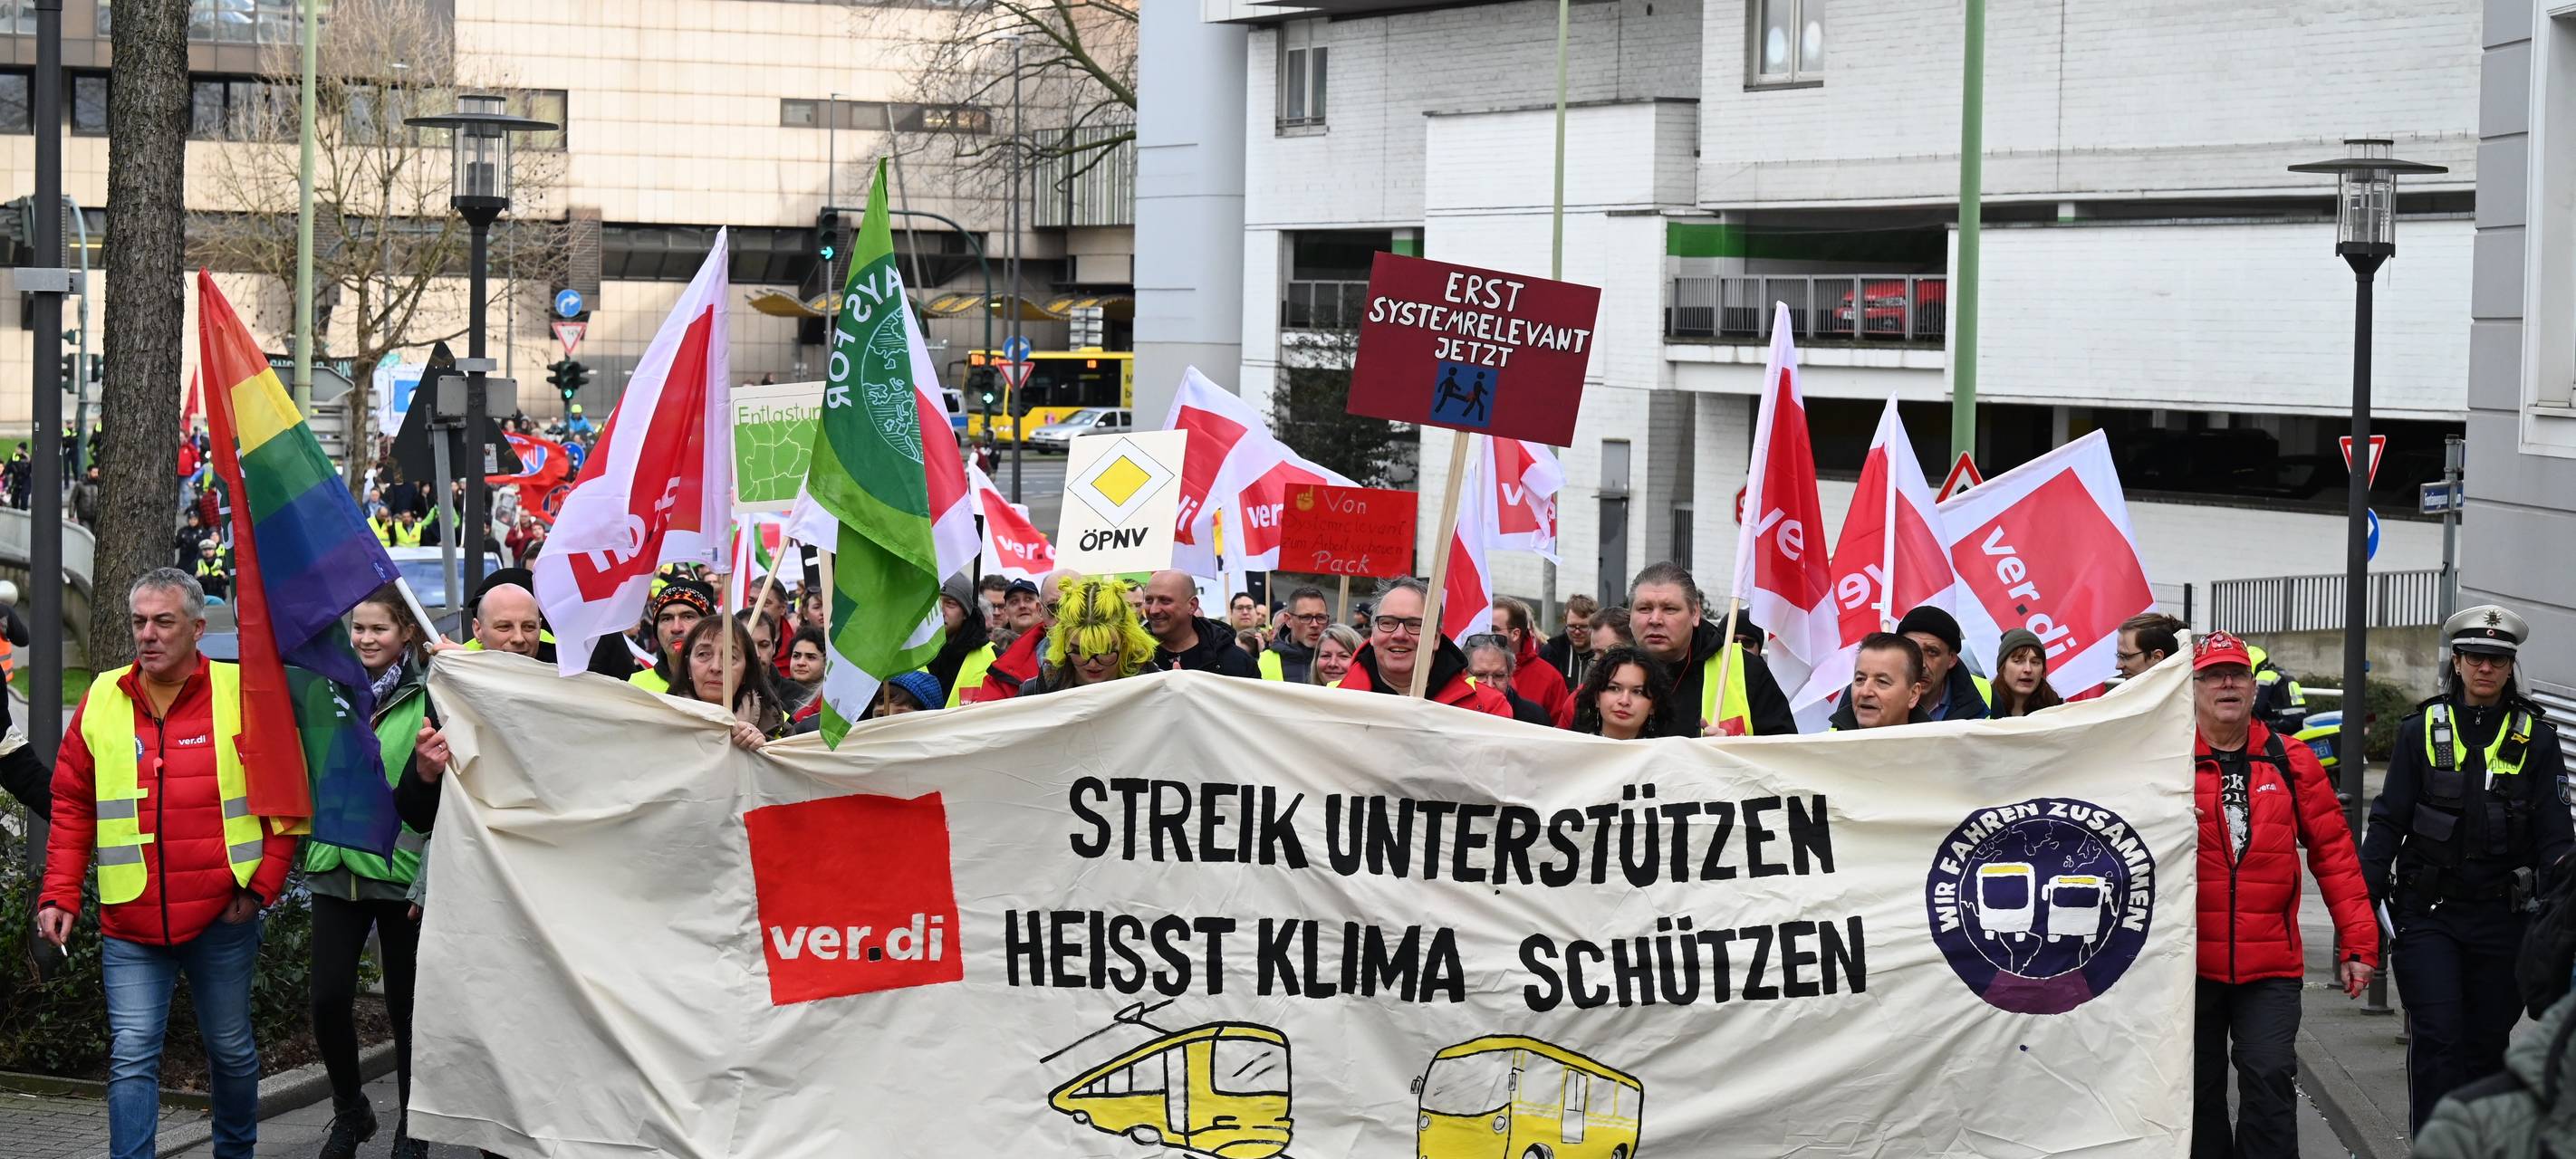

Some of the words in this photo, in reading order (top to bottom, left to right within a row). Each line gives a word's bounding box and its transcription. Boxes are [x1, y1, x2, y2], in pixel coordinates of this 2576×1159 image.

[1445, 272, 1524, 311] ERST
[1369, 297, 1591, 353] SYSTEMRELEVANT
[1435, 337, 1513, 368] JETZT
[1322, 490, 1366, 514] Von
[1080, 527, 1149, 551] ÖPNV
[1312, 551, 1370, 573] Pack
[1981, 525, 2077, 660] ver.di
[178, 735, 207, 745] ver.di
[1070, 776, 1309, 869] STREIK
[1325, 783, 1835, 888] UNTERSTÜTZEN
[1939, 803, 2039, 875] FAHREN
[2047, 802, 2151, 932] ZUSAMMEN
[1935, 882, 1959, 933] WIR
[769, 913, 945, 962] ver.di
[1004, 909, 1235, 996] HEISST
[1257, 917, 1466, 1002] KLIMA
[1518, 915, 1867, 1012] SCHÜTZEN
